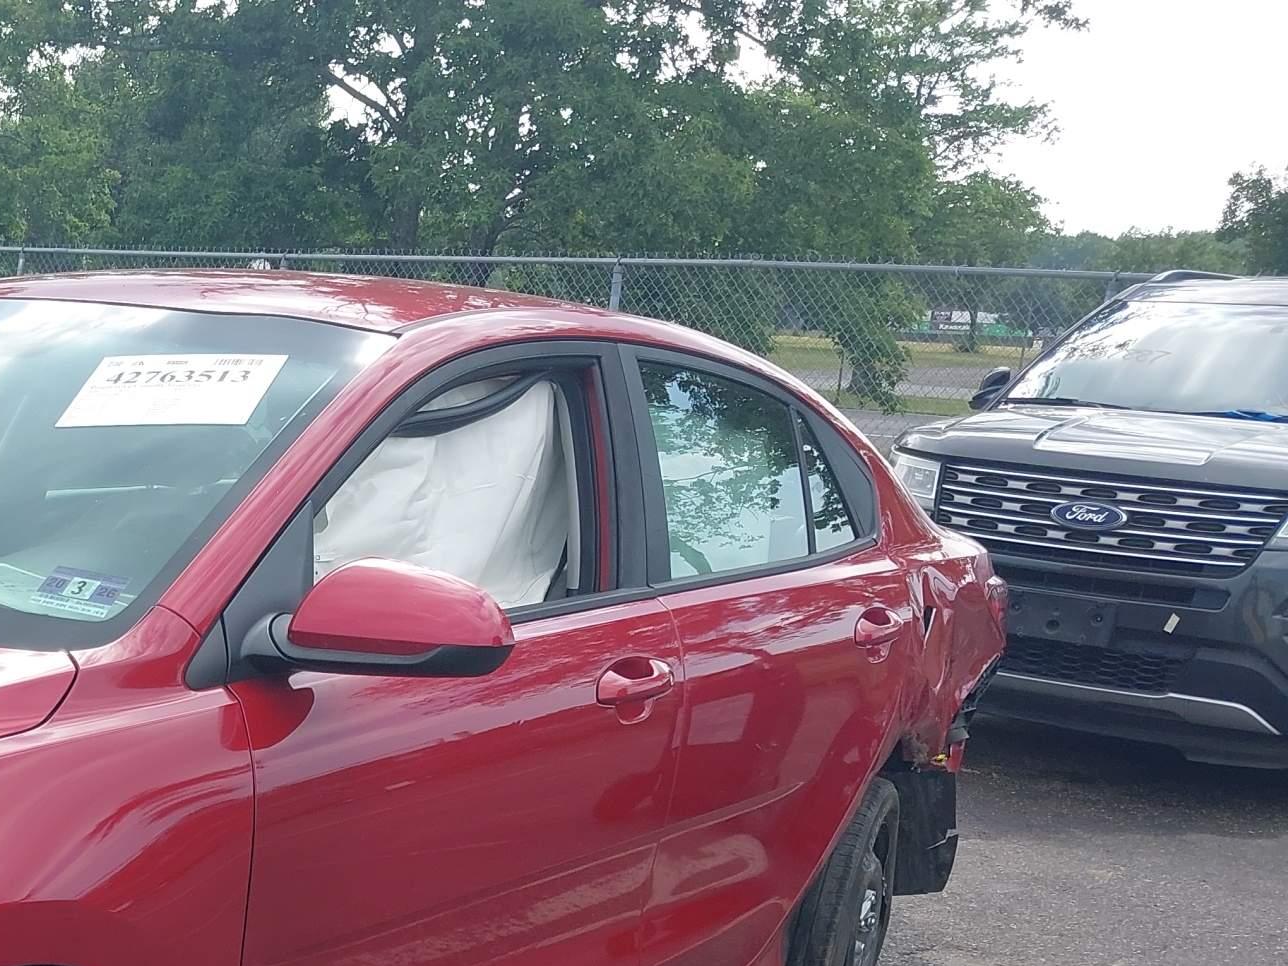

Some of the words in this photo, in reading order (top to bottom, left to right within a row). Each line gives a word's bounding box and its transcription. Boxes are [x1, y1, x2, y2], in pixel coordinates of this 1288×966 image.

[106, 369, 252, 385] 42763513
[1065, 504, 1109, 523] Ford
[45, 578, 65, 589] 20
[70, 580, 87, 595] 3
[96, 585, 118, 598] 26
